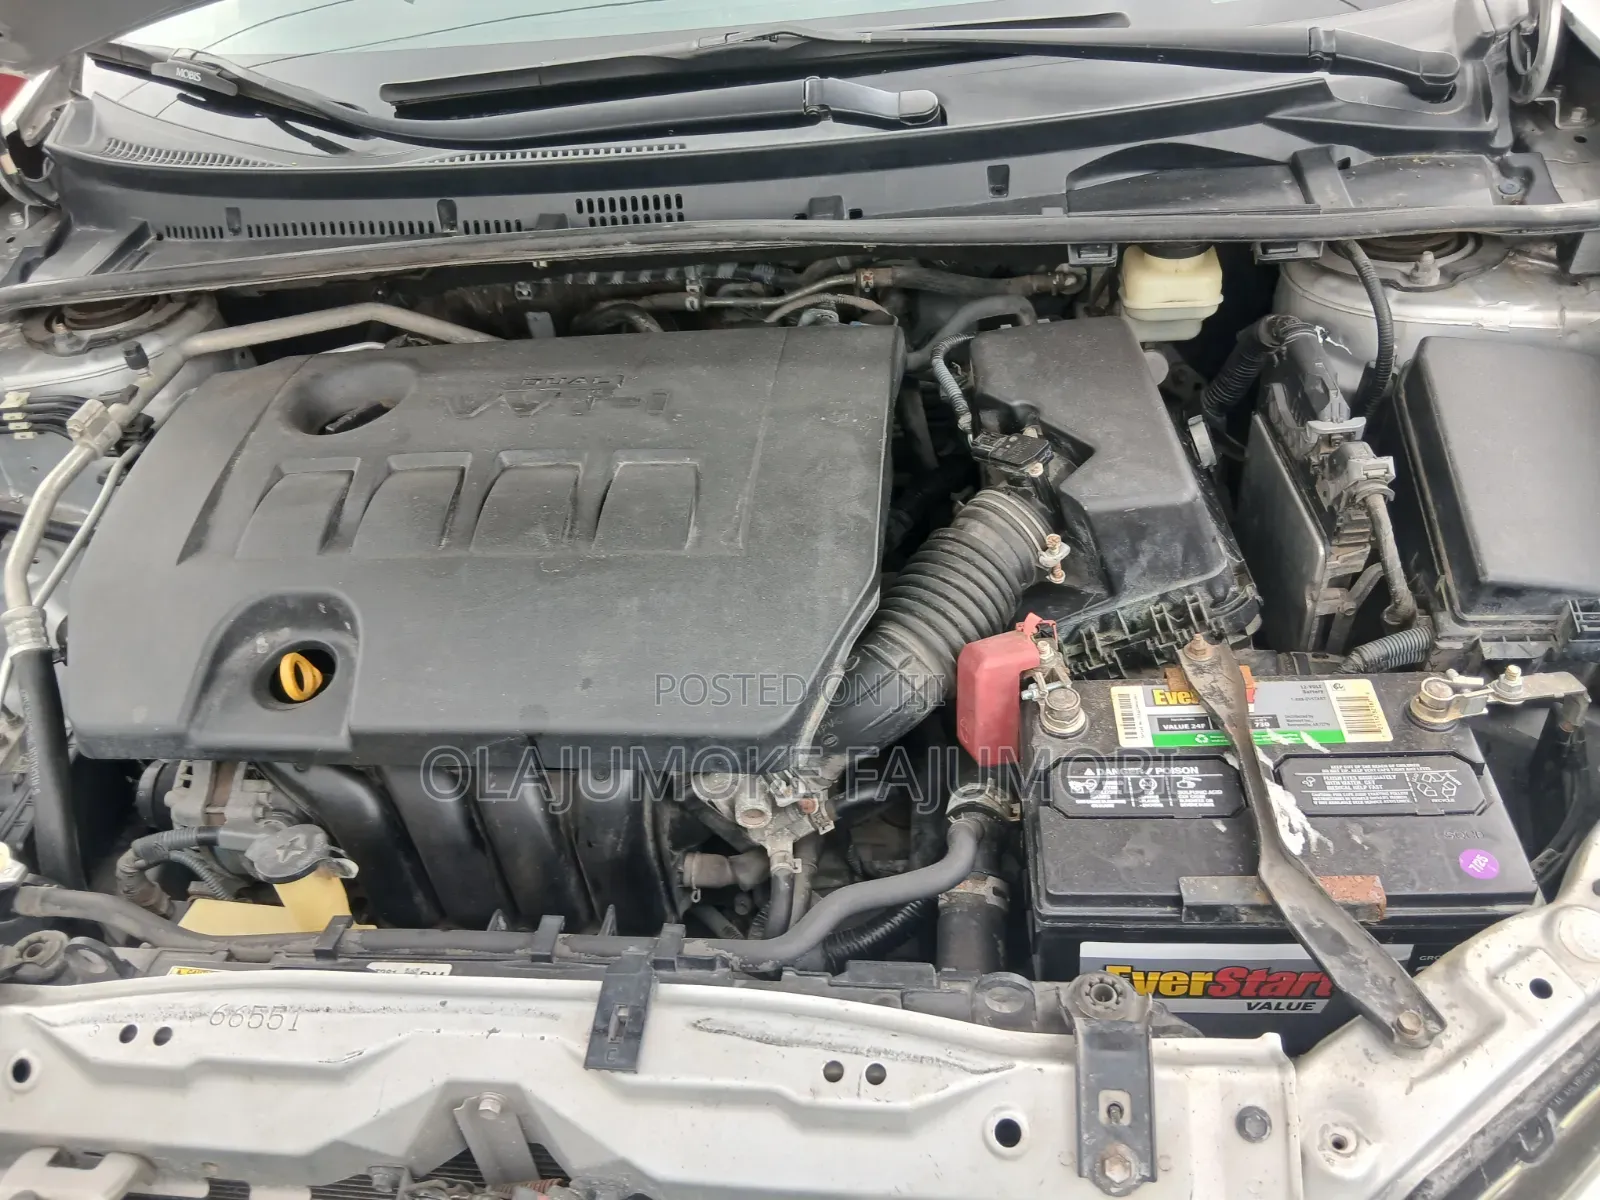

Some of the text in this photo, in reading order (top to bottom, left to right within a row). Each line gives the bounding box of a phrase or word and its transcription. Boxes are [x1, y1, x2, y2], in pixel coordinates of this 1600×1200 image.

[176, 67, 202, 82] MOBIS
[1096, 768, 1144, 776] DANGER
[1154, 766, 1200, 775] POISON
[1246, 1002, 1317, 1012] VALUE
[208, 1002, 300, 1032] 66551
